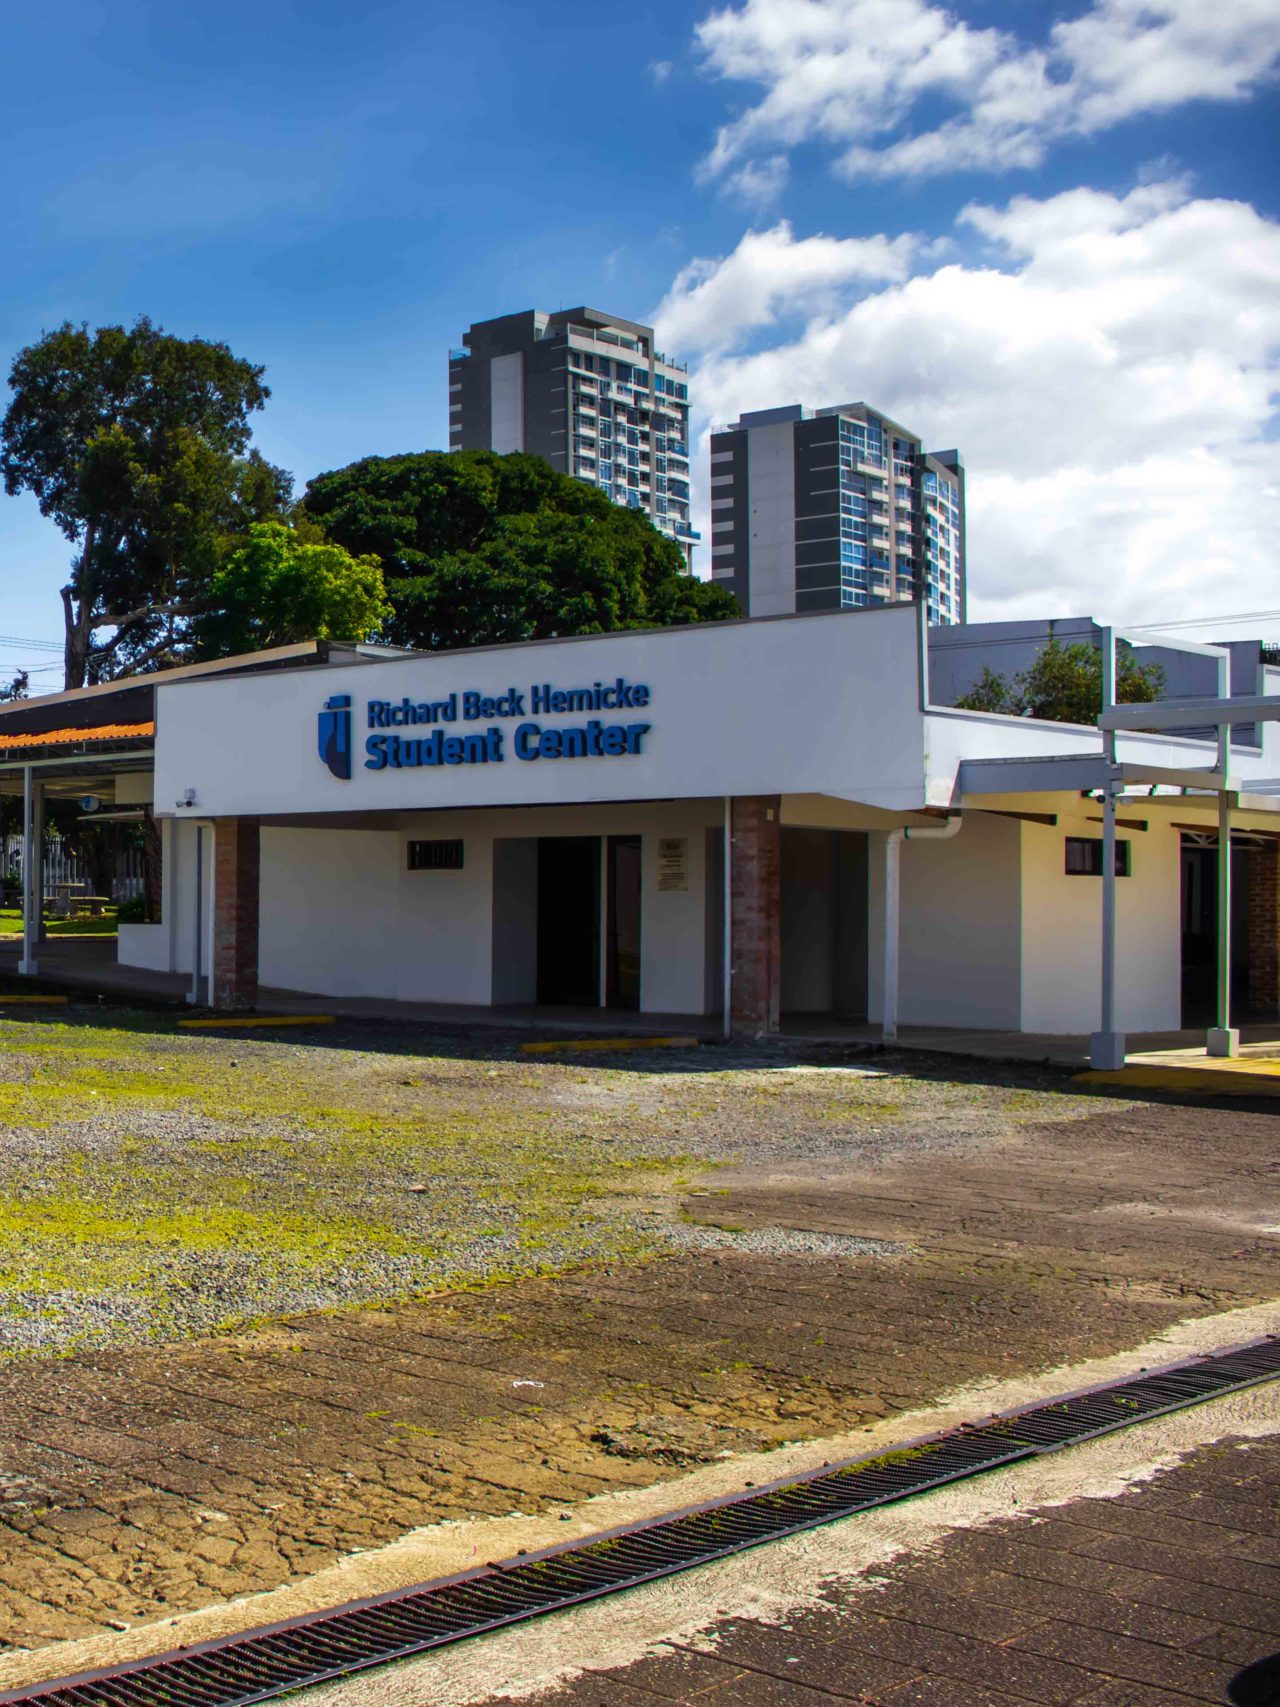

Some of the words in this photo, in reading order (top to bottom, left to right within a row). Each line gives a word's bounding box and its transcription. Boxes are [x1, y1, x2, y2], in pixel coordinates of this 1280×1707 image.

[367, 693, 458, 729] Richard
[463, 687, 526, 721] Beck
[531, 678, 651, 715] Hemicke
[364, 725, 505, 771] Student
[514, 719, 652, 762] Center
